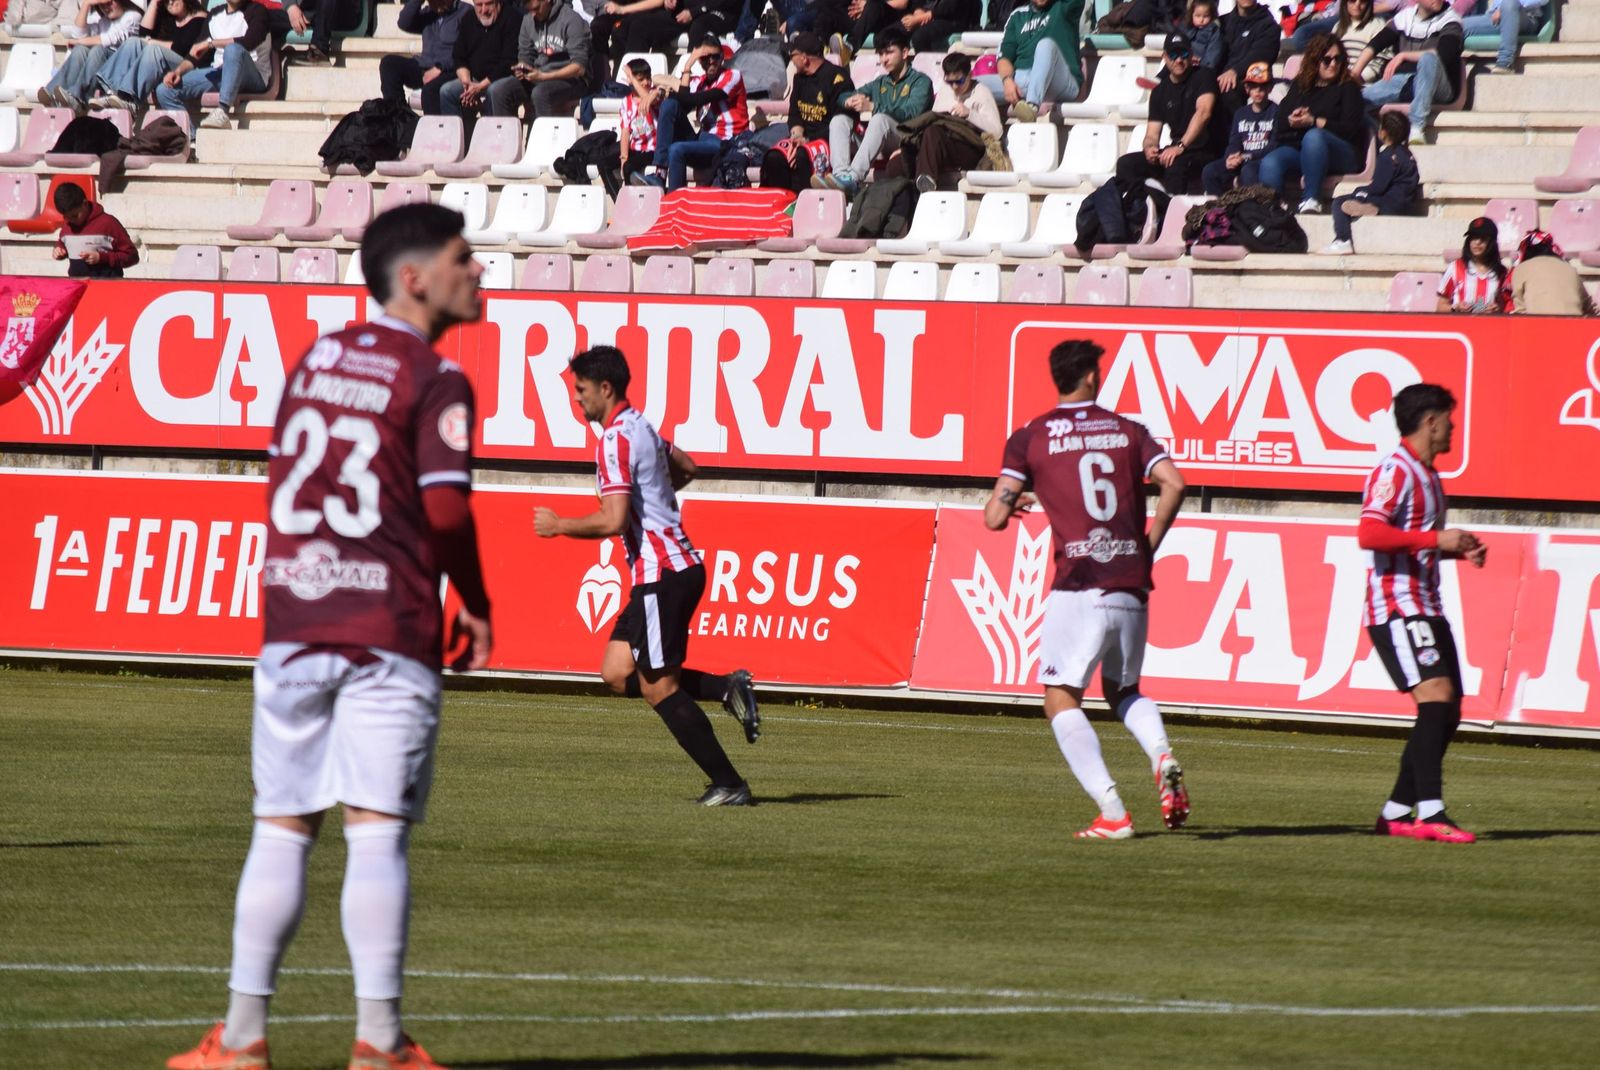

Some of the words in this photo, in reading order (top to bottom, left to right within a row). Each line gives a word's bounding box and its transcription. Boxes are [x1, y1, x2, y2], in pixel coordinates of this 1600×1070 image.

[483, 297, 964, 462] RURAL
[1095, 331, 1425, 468] AMAQ
[271, 406, 382, 538] 23
[1078, 452, 1118, 522] 6
[698, 549, 861, 609] RSUS
[688, 613, 831, 642] EARNING
[1406, 620, 1436, 648] 19
